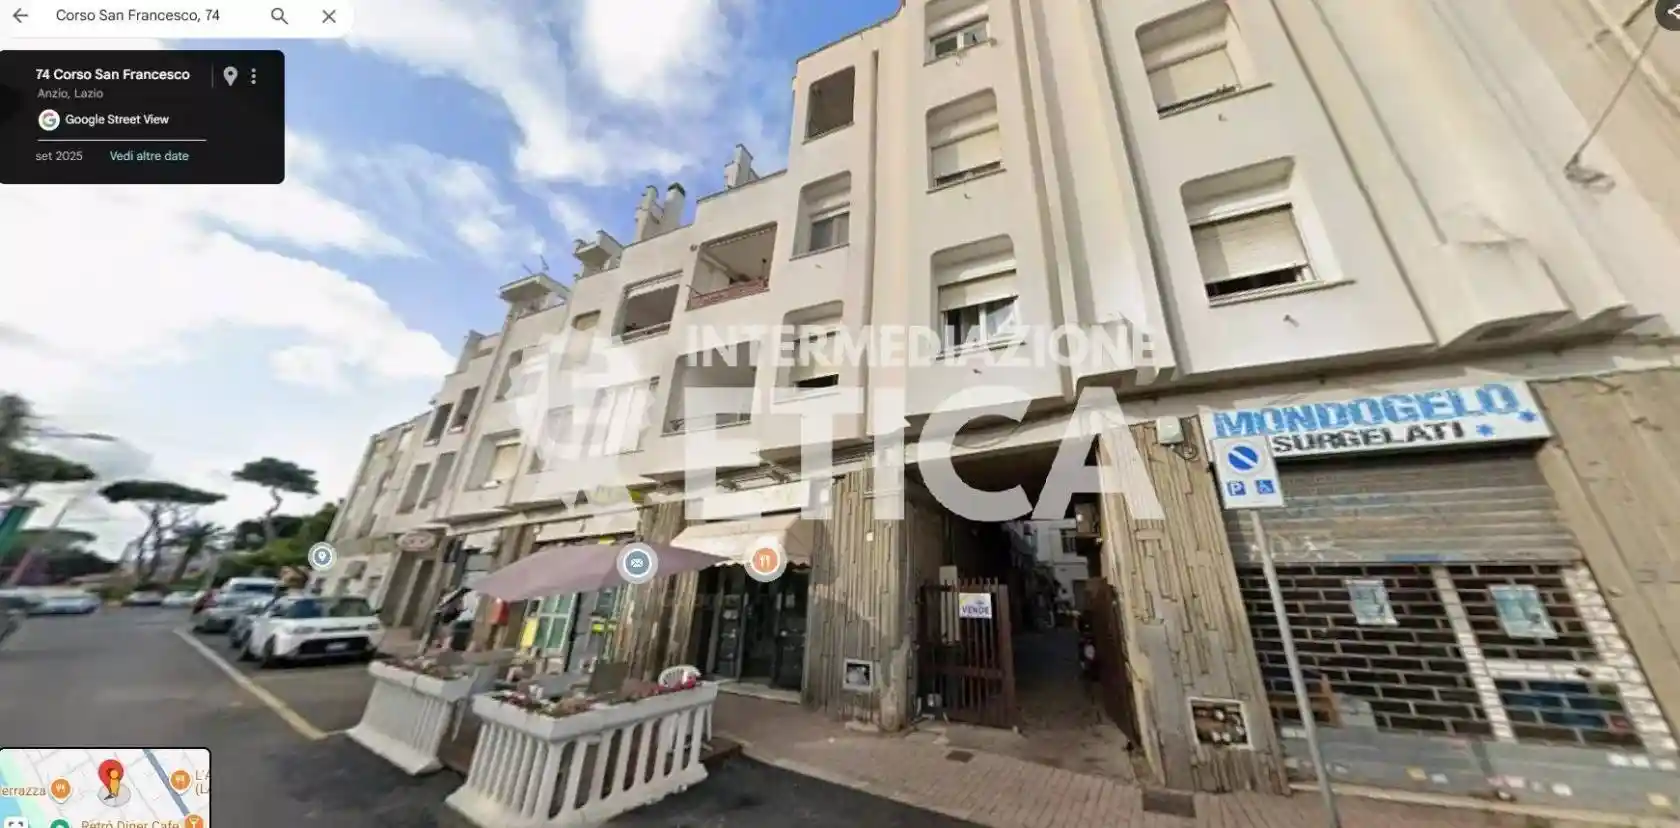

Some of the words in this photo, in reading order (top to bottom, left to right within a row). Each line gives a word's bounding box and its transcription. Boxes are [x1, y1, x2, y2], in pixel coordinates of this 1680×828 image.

[56, 9, 96, 22] Corso
[99, 9, 124, 22] San
[128, 9, 201, 24] Francesco,
[205, 9, 220, 22] 74
[36, 69, 50, 80] 74
[54, 69, 92, 80] Corso
[95, 69, 119, 80] San
[123, 69, 190, 80] Francesco
[38, 88, 71, 100] Anzio,
[74, 88, 104, 99] Lazio
[65, 114, 105, 126] Google
[108, 114, 141, 125] Street
[144, 114, 169, 125] View
[36, 151, 52, 161] set
[56, 151, 83, 161] 2025
[110, 150, 134, 161] Vedi
[137, 150, 161, 161] altre
[164, 150, 189, 161] date
[1213, 383, 1520, 438] MONDOGELO
[1274, 421, 1465, 453] SURGELATI
[1, 787, 47, 796] errazza
